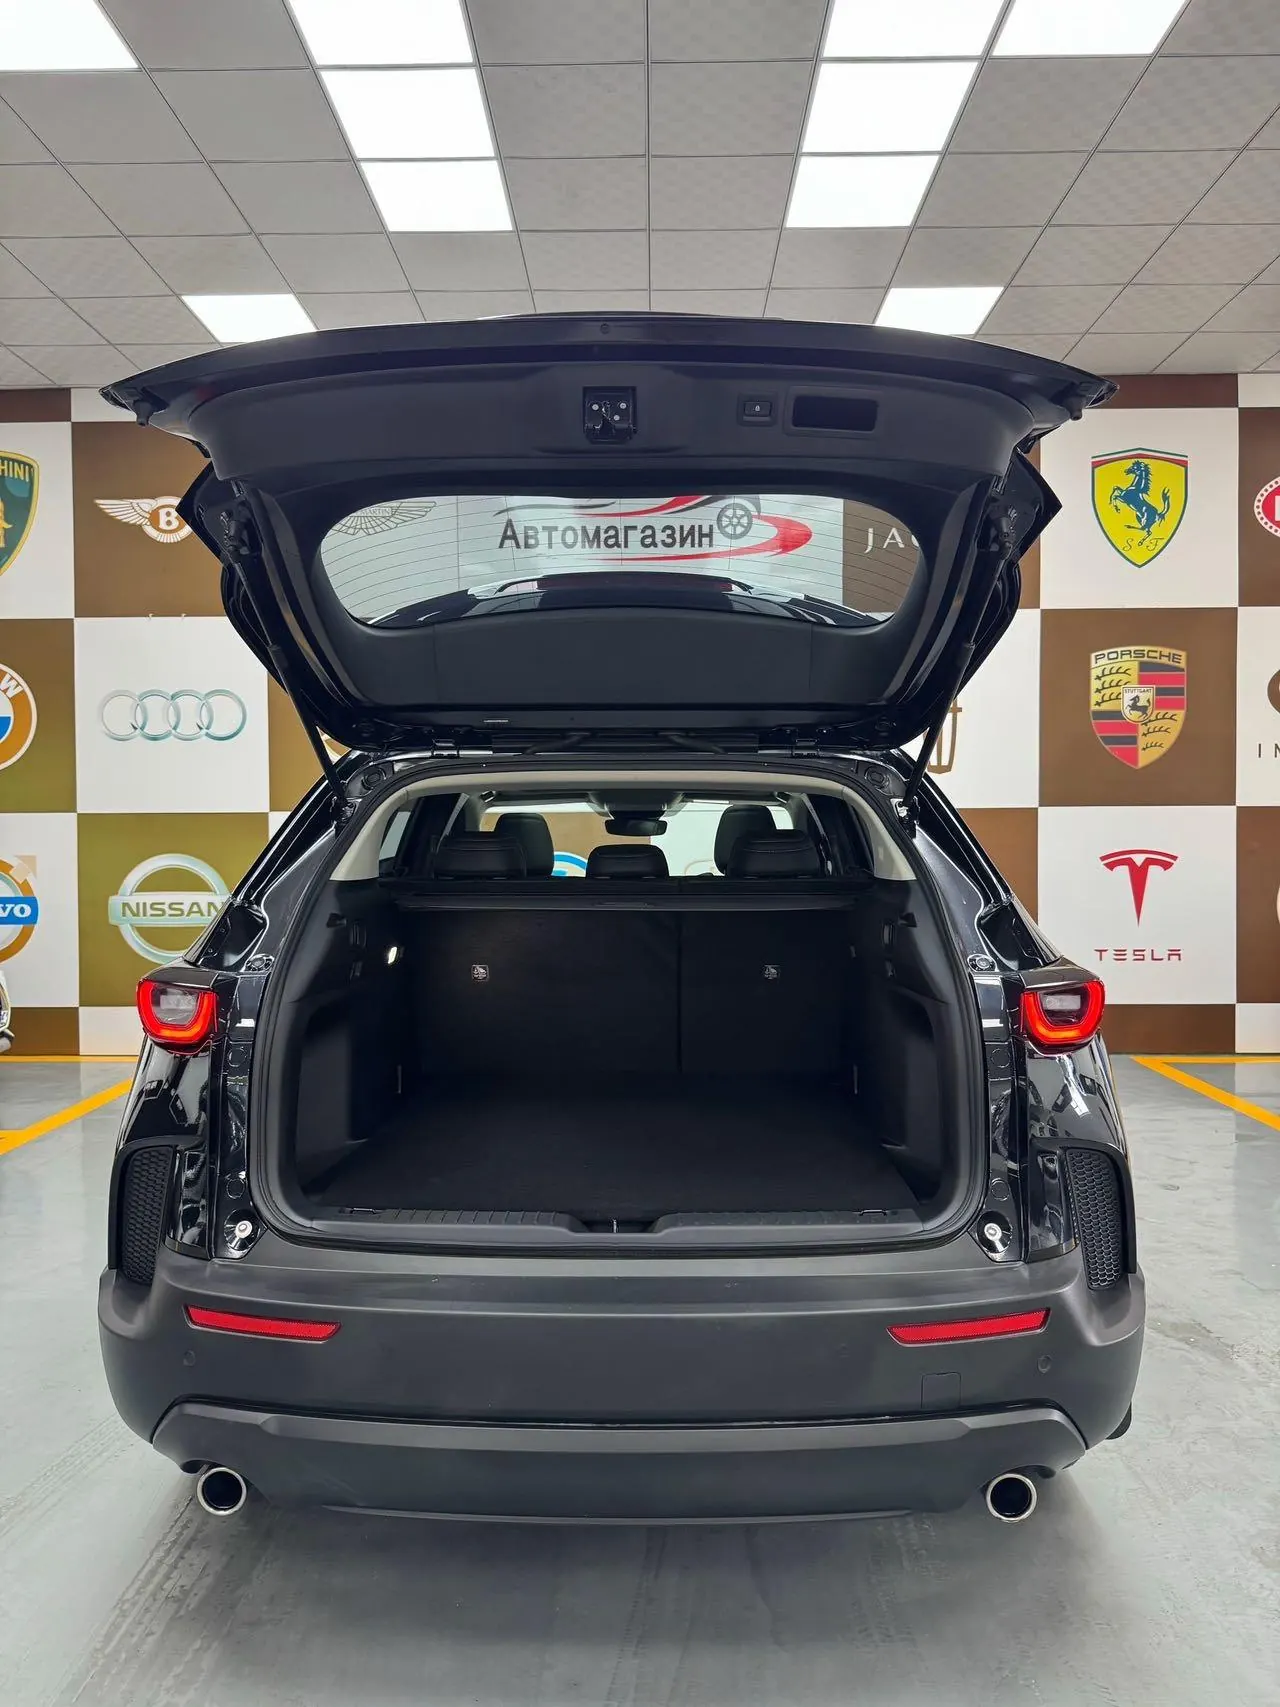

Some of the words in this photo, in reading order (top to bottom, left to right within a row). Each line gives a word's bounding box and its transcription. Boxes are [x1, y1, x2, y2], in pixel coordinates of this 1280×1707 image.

[498, 518, 713, 549] Автомагазин
[864, 527, 920, 554] JA
[1122, 537, 1134, 552] S
[1094, 649, 1182, 664] PORSCHE
[1094, 949, 1182, 961] TESLA
